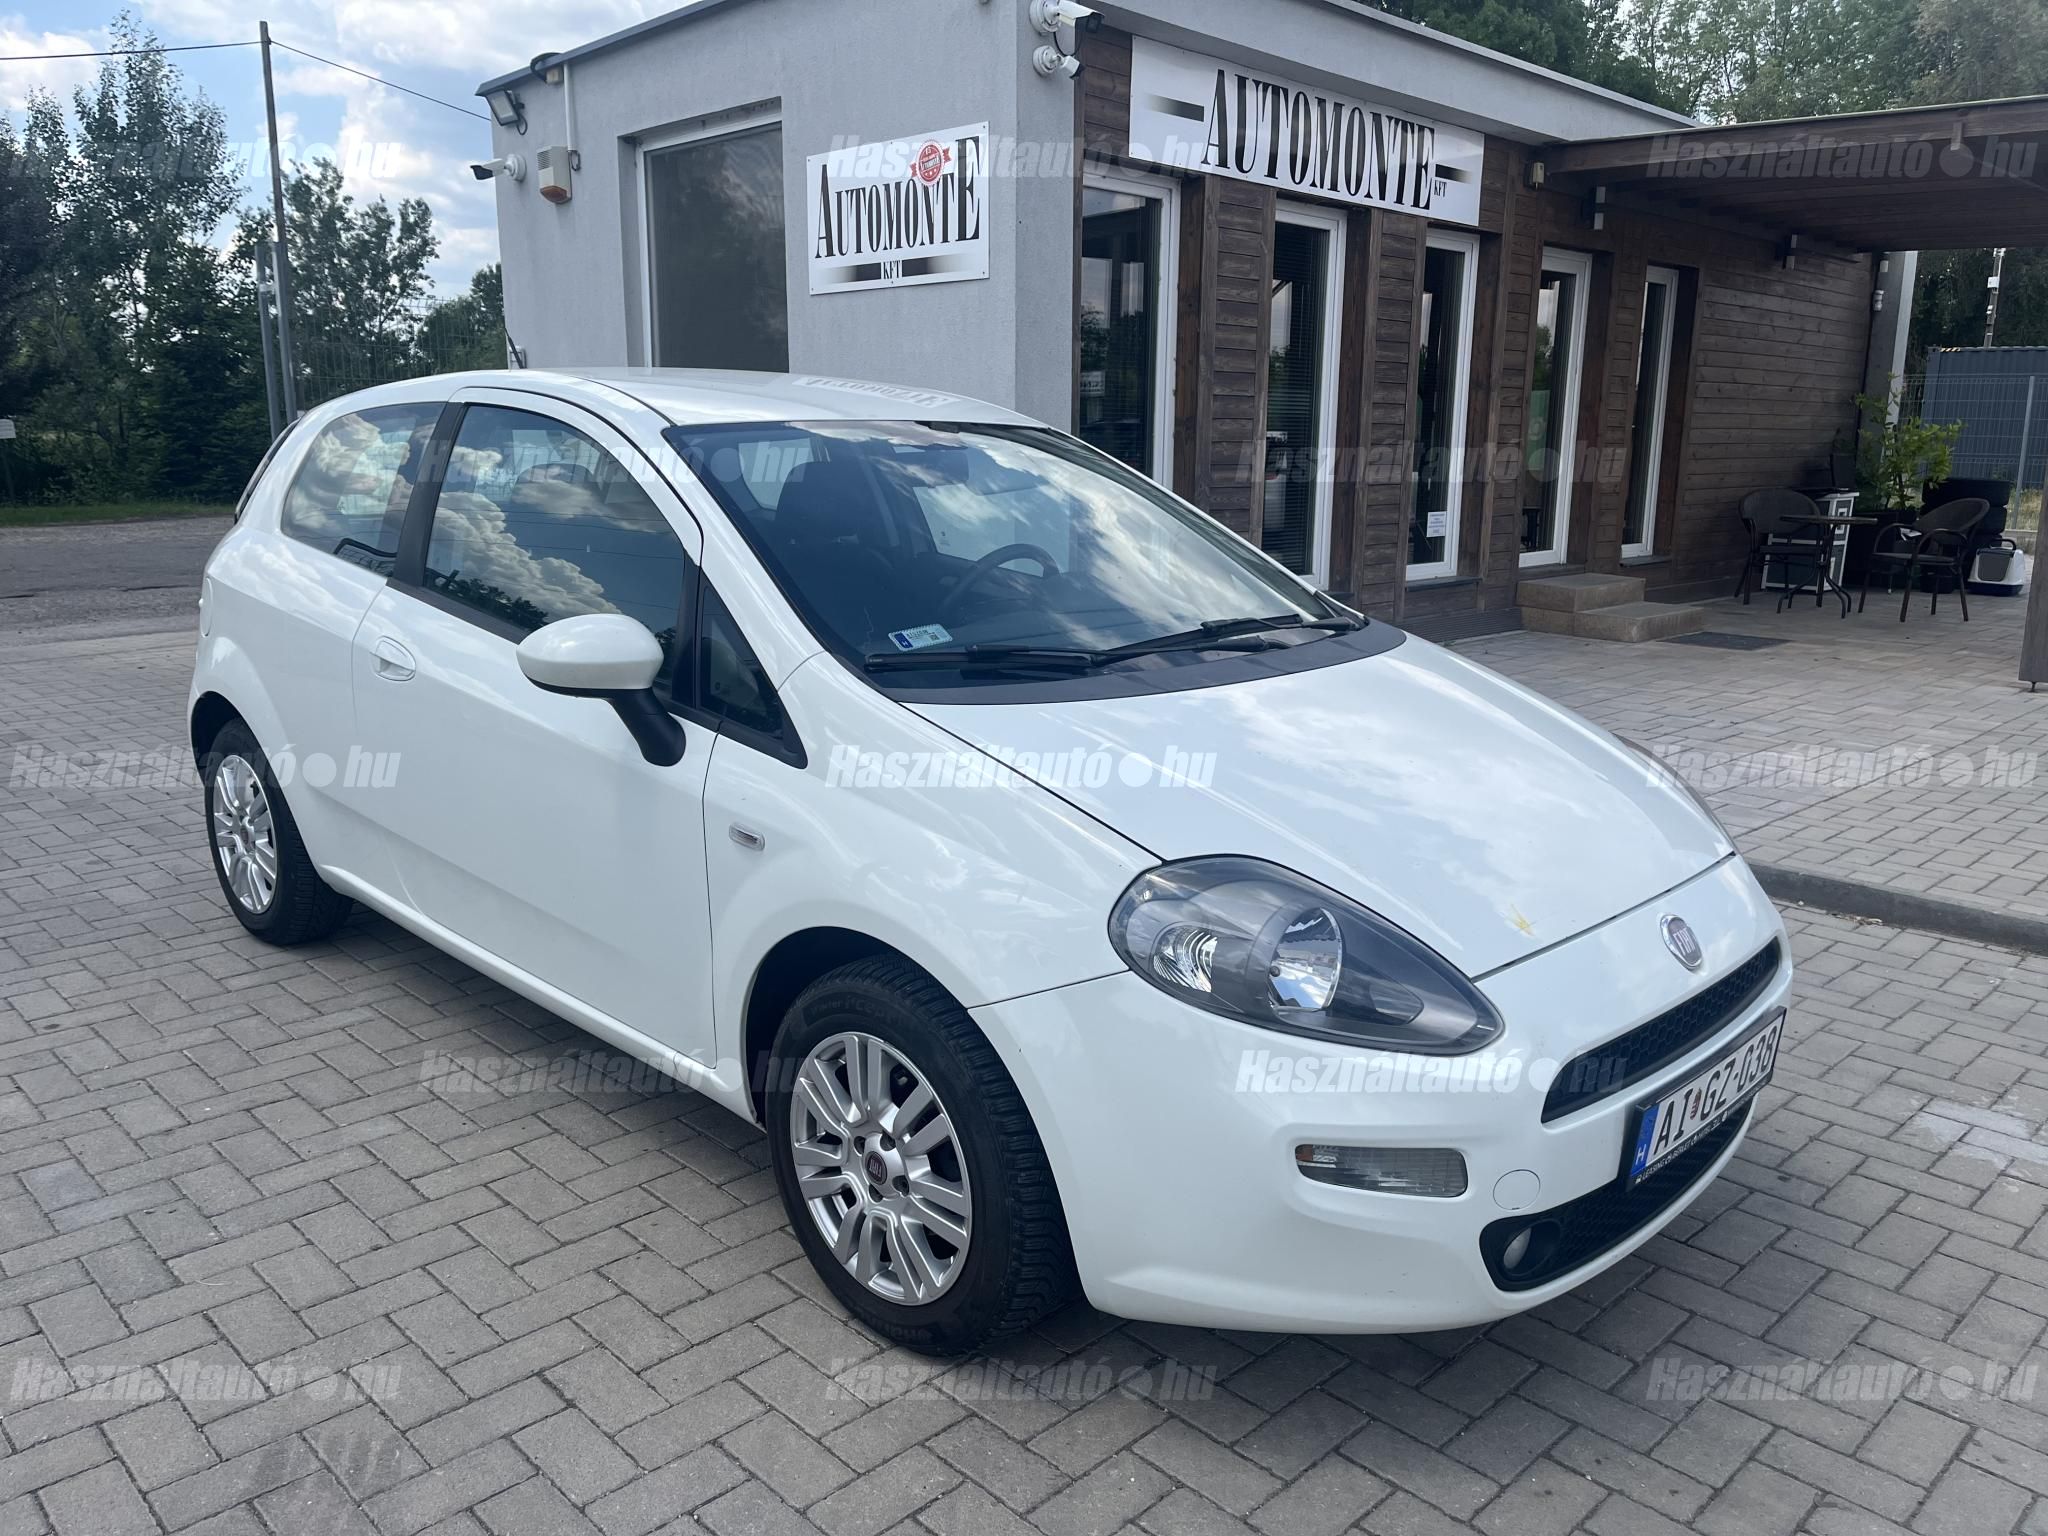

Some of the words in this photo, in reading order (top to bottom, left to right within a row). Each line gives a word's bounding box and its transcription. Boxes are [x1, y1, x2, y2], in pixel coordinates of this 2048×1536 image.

[1201, 69, 1435, 210] AUTOMONTE
[815, 136, 979, 258] AUTOMONTE
[1434, 180, 1447, 197] KFT
[883, 260, 900, 279] KFT
[1673, 928, 1696, 956] FIAT
[1654, 1088, 1693, 1155] AI
[1700, 1026, 1777, 1121] GZ-038
[1636, 1144, 1646, 1165] H
